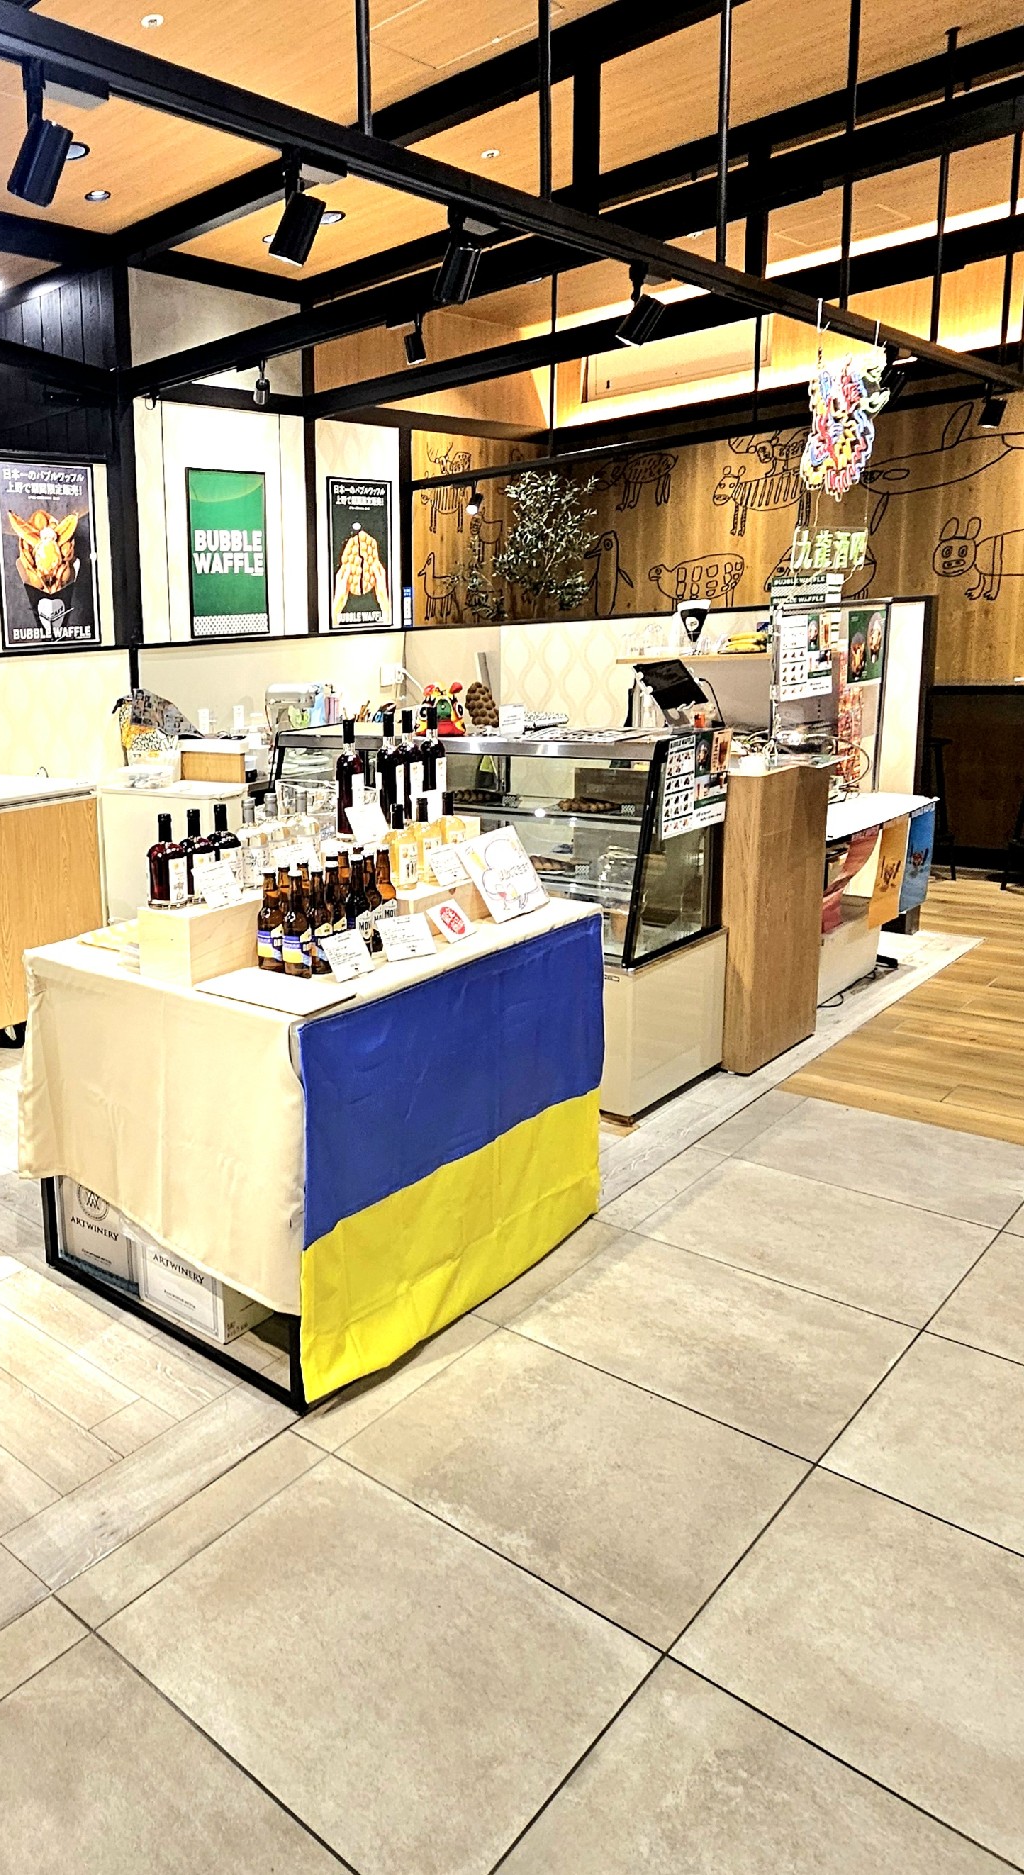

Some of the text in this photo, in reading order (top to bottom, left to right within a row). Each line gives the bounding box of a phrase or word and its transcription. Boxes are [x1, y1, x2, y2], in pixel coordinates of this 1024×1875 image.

[194, 529, 263, 552] BUBBLE
[193, 552, 264, 574] WAFFLE
[13, 625, 91, 640] BUBBLE WAFFLE
[70, 1215, 119, 1242] ARTWINERY
[152, 1254, 205, 1284] ARTWINERY
